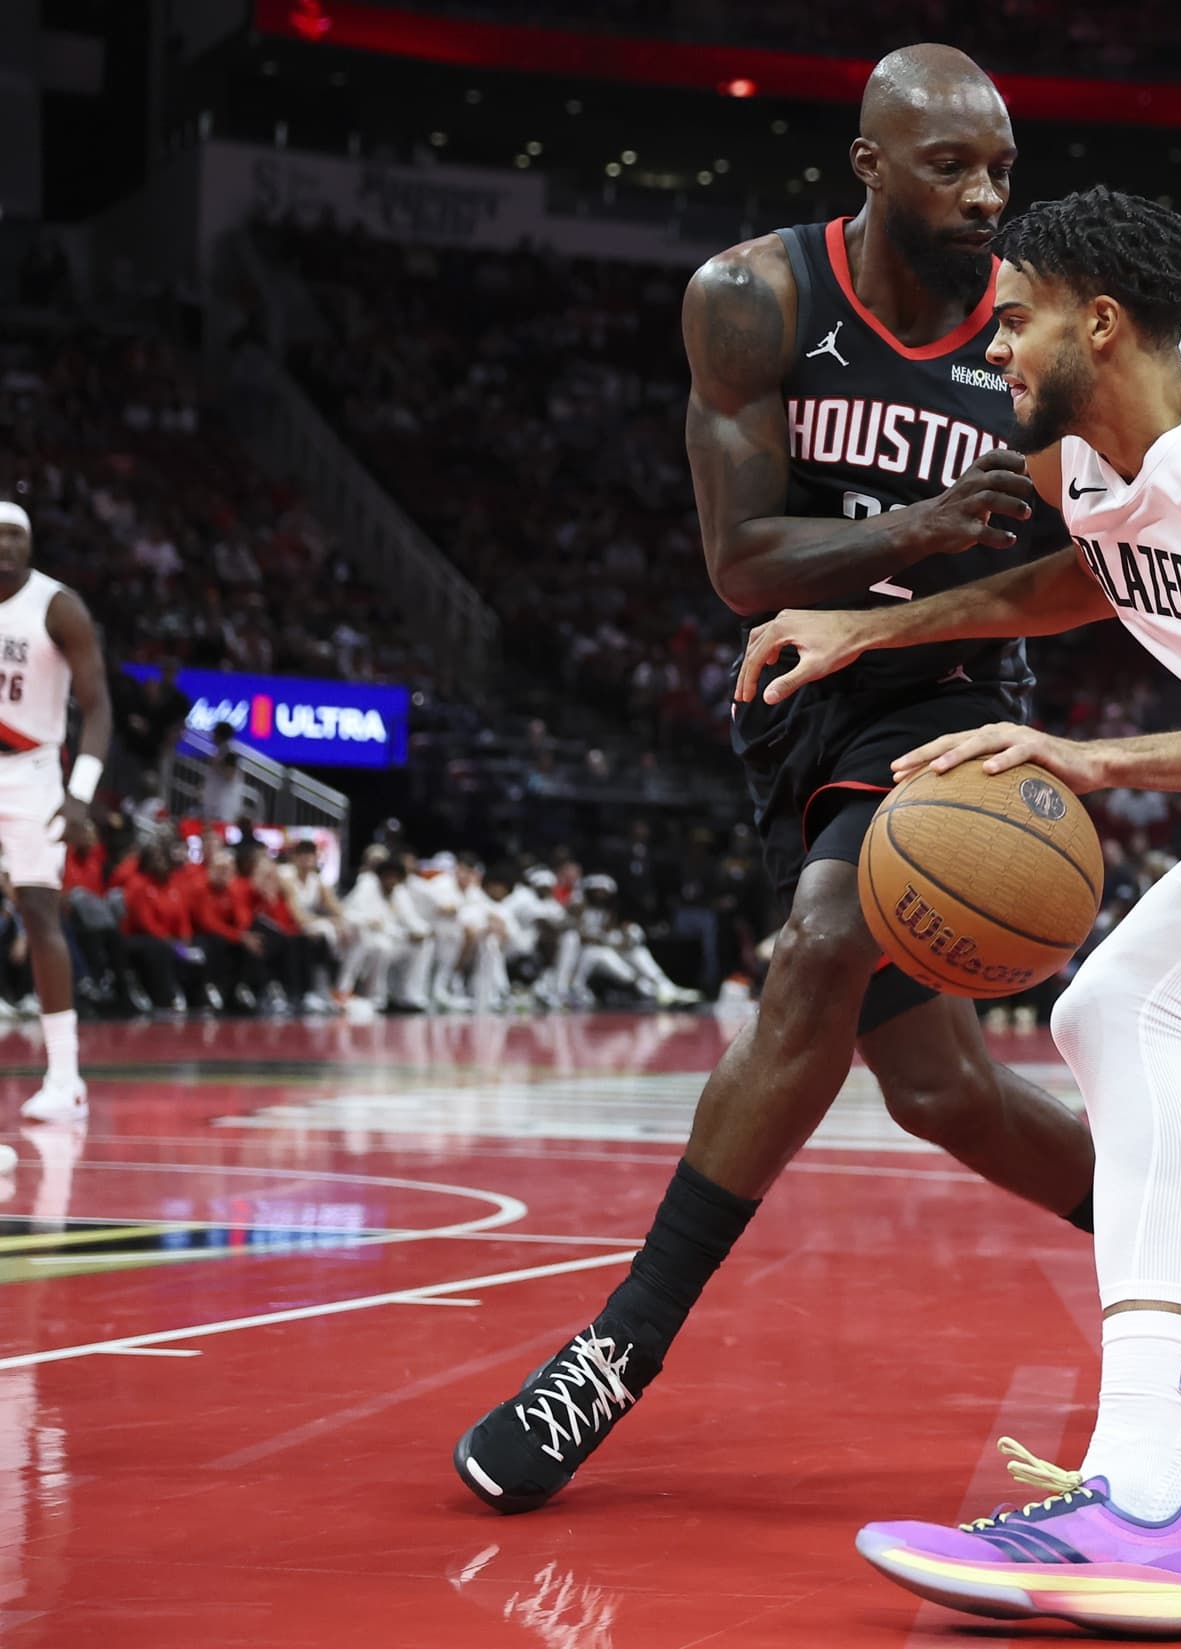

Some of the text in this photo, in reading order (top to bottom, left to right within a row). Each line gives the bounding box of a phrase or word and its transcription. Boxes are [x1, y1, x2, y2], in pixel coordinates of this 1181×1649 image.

[951, 373, 1007, 392] HERMANN
[0, 635, 29, 666] RS
[275, 702, 388, 743] ULTRA
